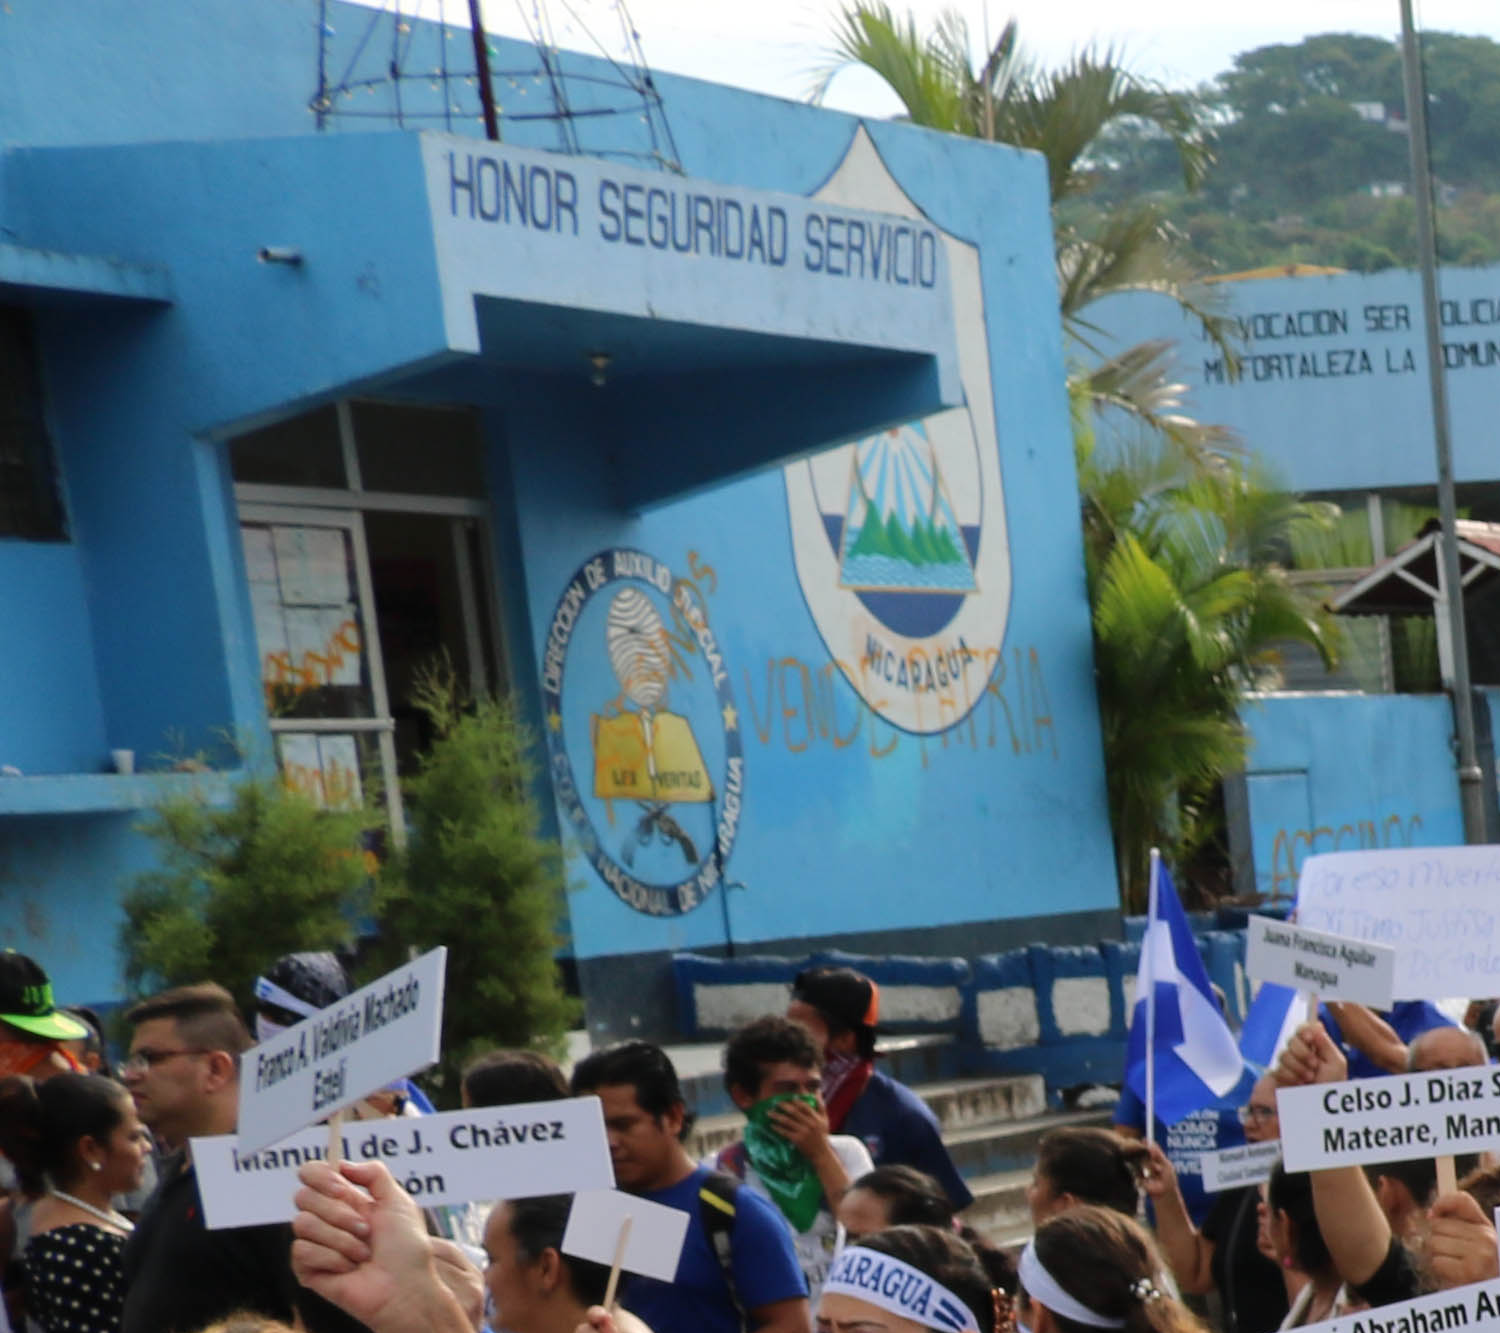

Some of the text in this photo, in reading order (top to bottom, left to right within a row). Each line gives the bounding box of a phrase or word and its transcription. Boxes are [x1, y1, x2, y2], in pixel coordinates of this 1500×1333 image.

[449, 153, 937, 289] HONOR SEGURIDAD SERVICIO
[1363, 304, 1412, 333] SER
[1385, 349, 1416, 375] LA
[1322, 1086, 1392, 1115] Celso
[1398, 1080, 1421, 1107] J.
[360, 1133, 399, 1161] de
[406, 1129, 433, 1157] J.
[449, 1120, 566, 1151] Chávez
[1322, 1118, 1439, 1155] Mateare,
